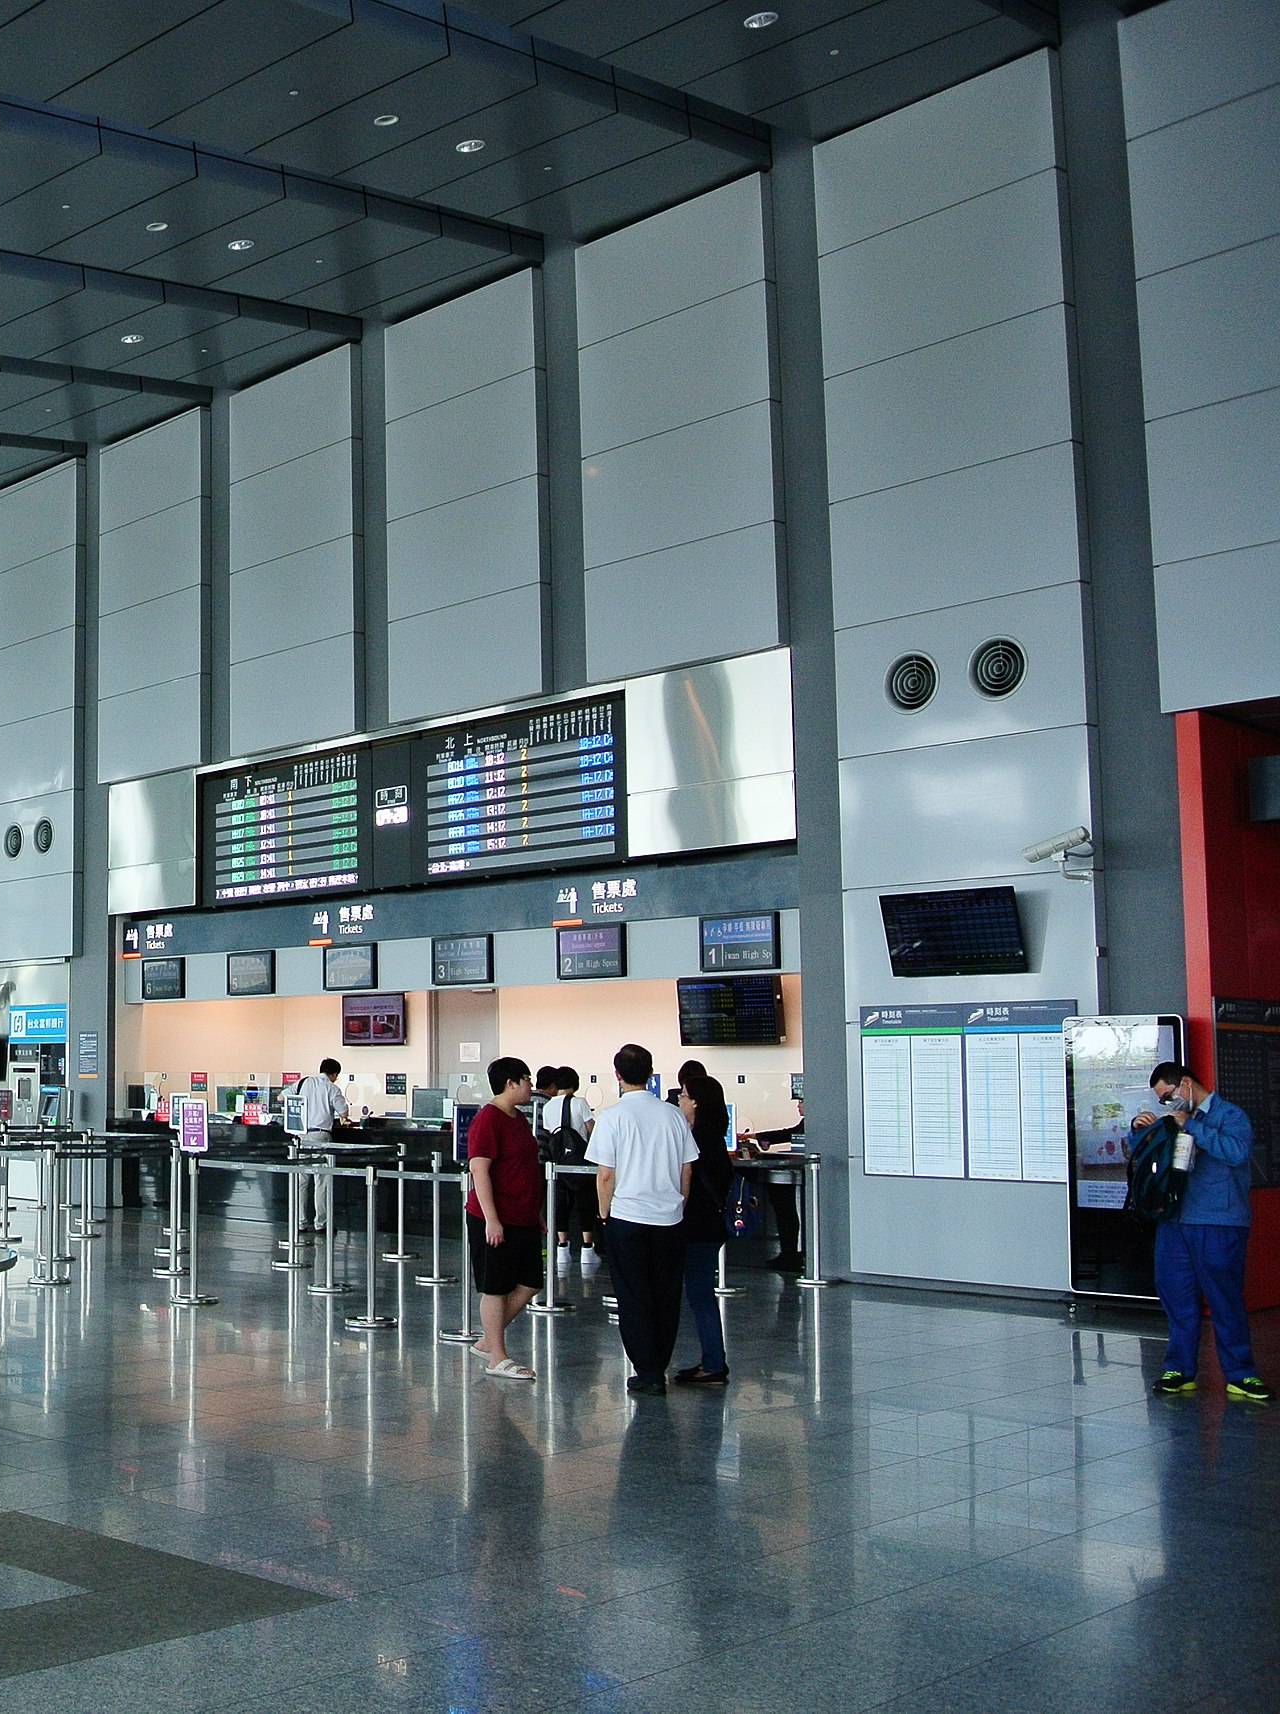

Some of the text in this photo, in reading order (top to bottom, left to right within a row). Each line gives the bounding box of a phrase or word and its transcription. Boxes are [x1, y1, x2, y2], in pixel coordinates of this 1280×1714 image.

[485, 769, 505, 783] 11:12
[287, 790, 293, 801] 1
[287, 805, 293, 816] 1
[287, 820, 293, 830] 1
[287, 835, 293, 846] 1
[287, 850, 293, 861] 1
[287, 865, 293, 875] 1
[591, 879, 638, 900] 售票處
[339, 904, 374, 924] 售票處
[592, 902, 624, 914] Tickets
[146, 923, 173, 939] 售票處
[339, 924, 363, 935] Tickets
[146, 940, 165, 950] Tickets
[708, 948, 716, 964] 1
[742, 950, 759, 963] High
[438, 964, 445, 979] 3
[564, 958, 572, 973] 2
[586, 958, 600, 970] High
[146, 982, 152, 995] 6
[232, 978, 237, 990] 5
[881, 1009, 903, 1019] 時刻表
[986, 1007, 1009, 1017] 時刻表
[27, 1017, 63, 1029] 台北富邦銀行
